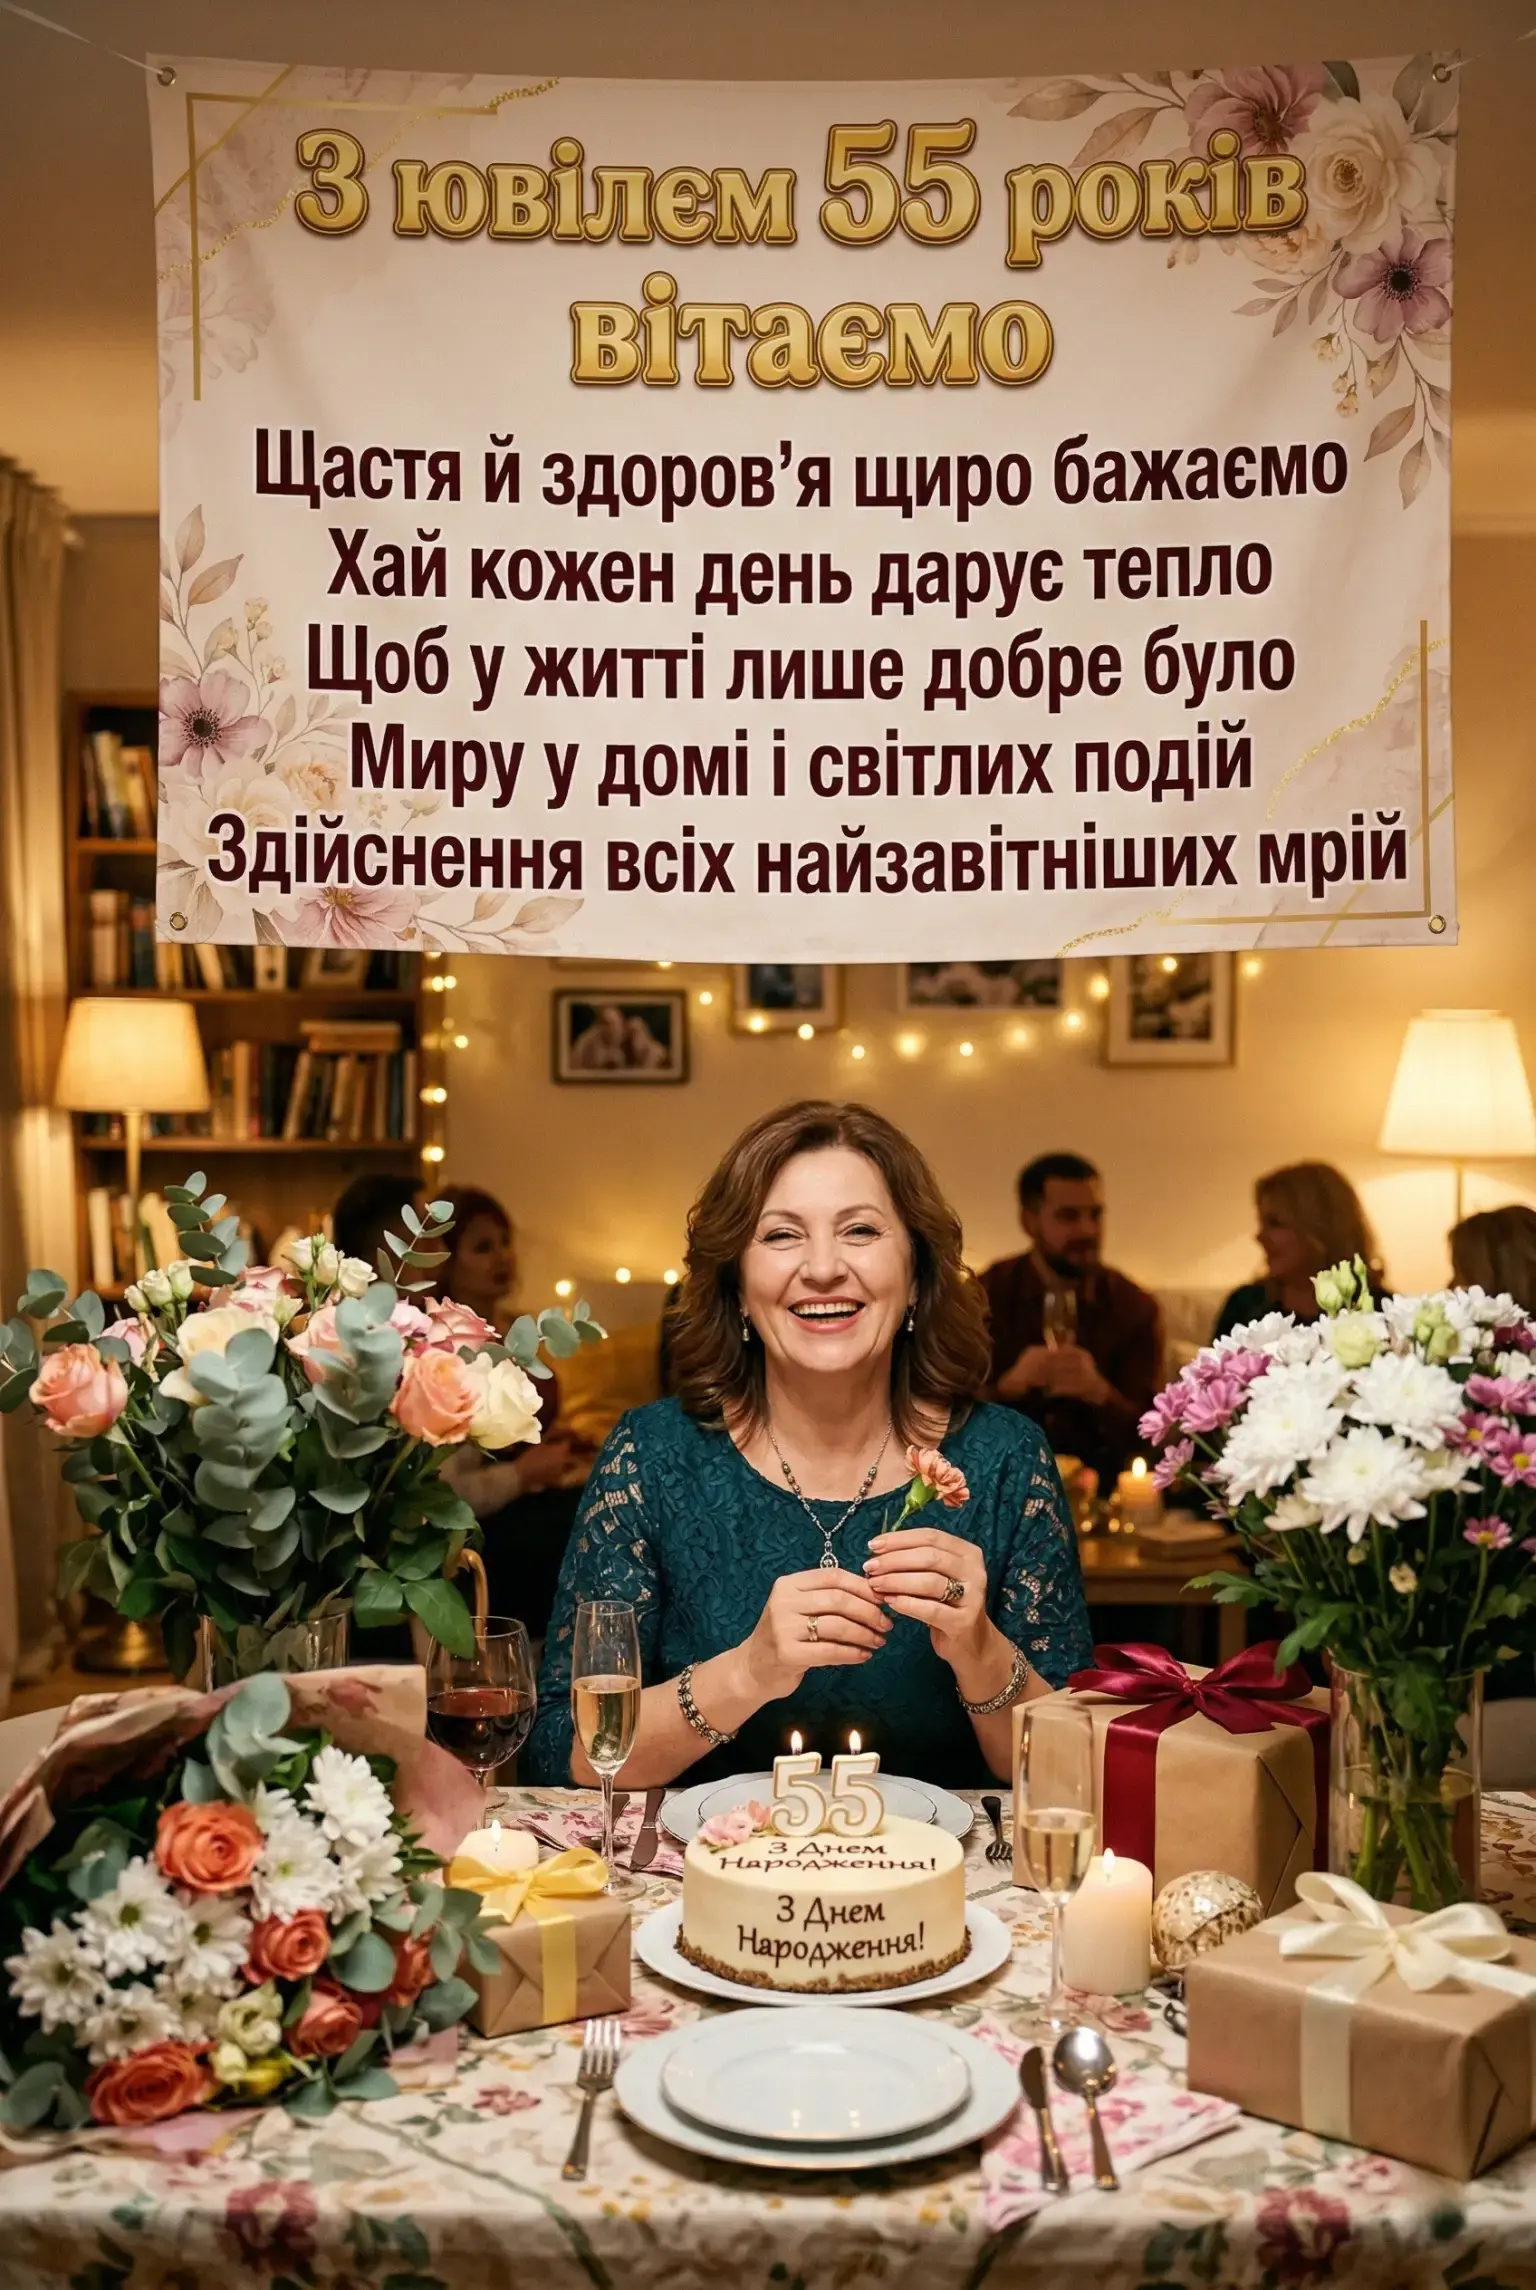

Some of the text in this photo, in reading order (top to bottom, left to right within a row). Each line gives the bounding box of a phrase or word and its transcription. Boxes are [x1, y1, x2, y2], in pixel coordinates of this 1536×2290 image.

[293, 117, 1309, 268] З ювілєм 55 років
[569, 270, 1055, 388] вітаємо
[256, 428, 1348, 523] Щастя й здоров’я щиро бажаємо
[327, 527, 1272, 619] Хай кожен день дарує тепло
[308, 623, 1295, 714] Щоб у житті лише добре було
[351, 719, 1251, 810] Миру у домі і світлих подій
[207, 810, 1406, 899] Здійснення всіх найзавітніших мрій
[771, 1752, 884, 1837] 55
[719, 1857, 937, 1873] Народження!
[768, 1841, 887, 1857] З Днем
[737, 1922, 925, 1968] Народження!
[776, 1894, 886, 1933] З Днем
